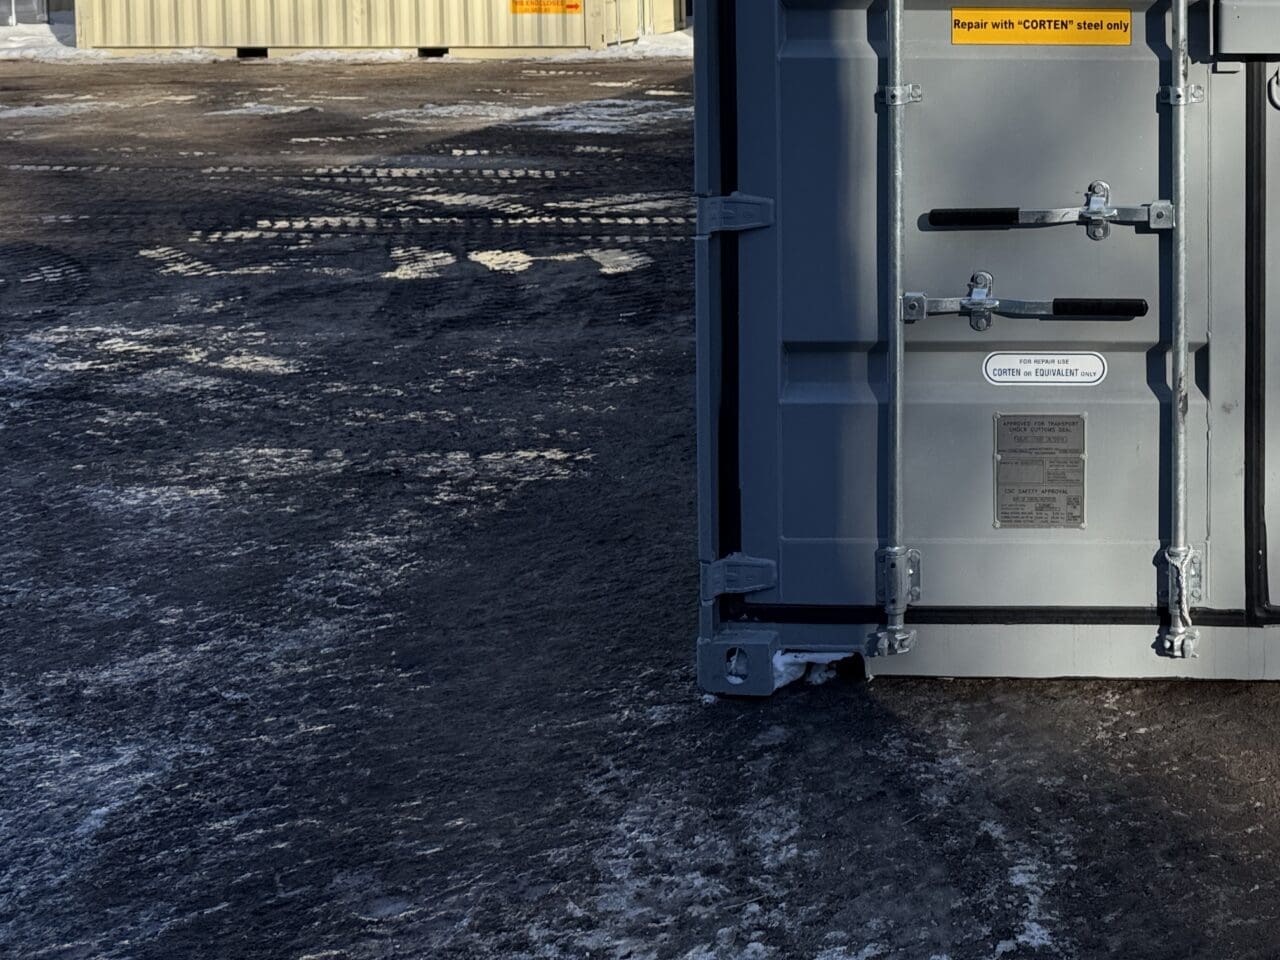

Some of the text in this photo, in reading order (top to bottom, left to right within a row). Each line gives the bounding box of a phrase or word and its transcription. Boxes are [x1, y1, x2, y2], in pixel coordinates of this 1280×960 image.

[953, 19, 1130, 32] Repair with "CORTEN" steel only
[992, 368, 1021, 377] CORTEN
[1035, 368, 1079, 377] EQUIVALENT
